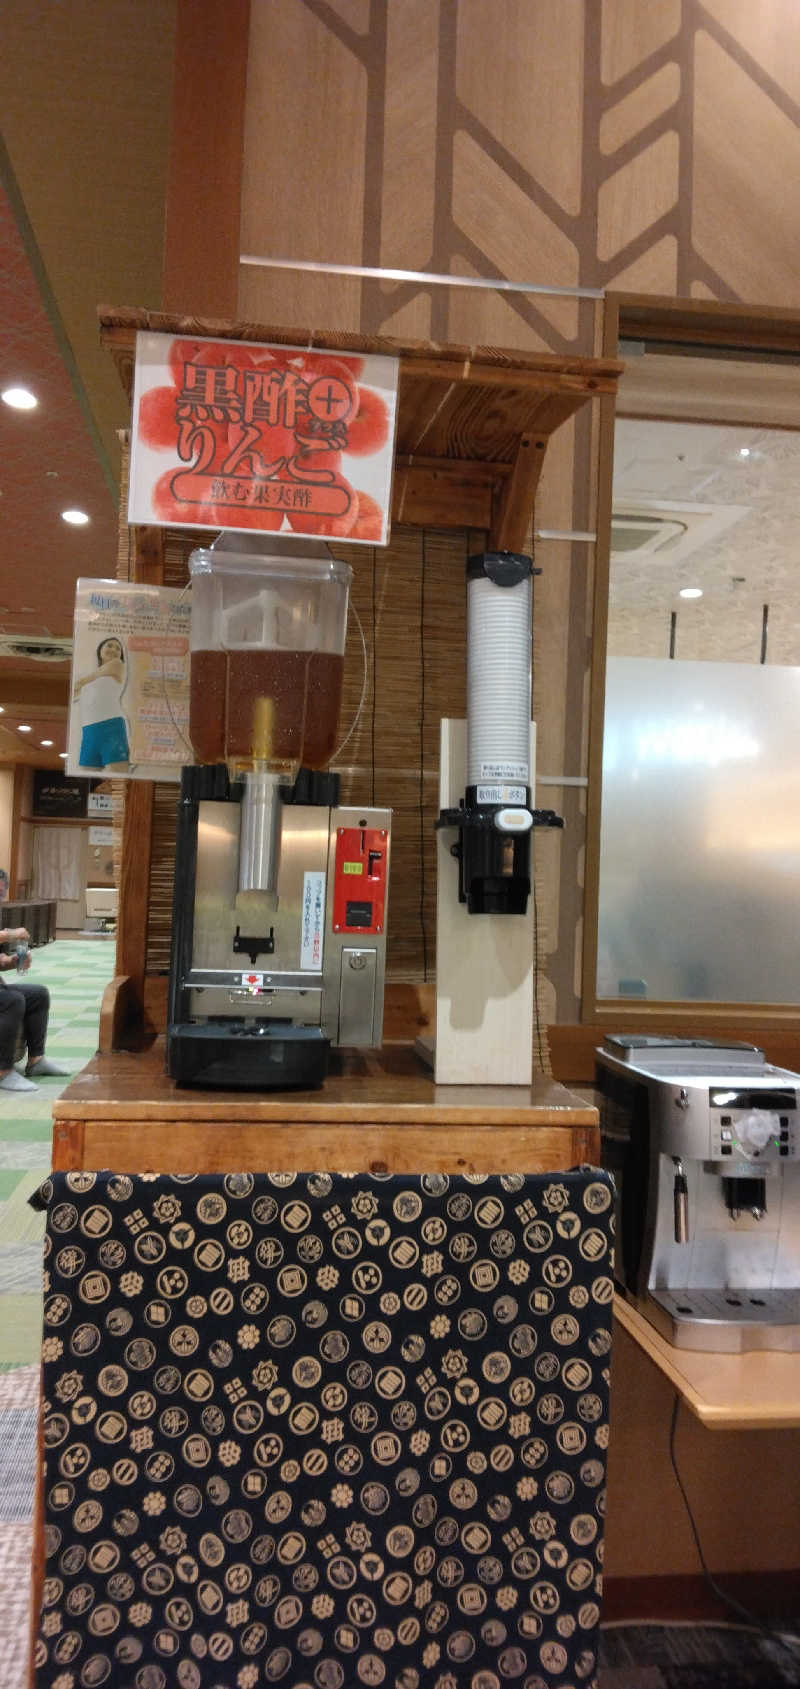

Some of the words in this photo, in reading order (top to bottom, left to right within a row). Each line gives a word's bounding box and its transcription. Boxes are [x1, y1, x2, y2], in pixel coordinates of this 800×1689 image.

[176, 418, 348, 484] りんご
[210, 479, 312, 508] 飲む果実酢
